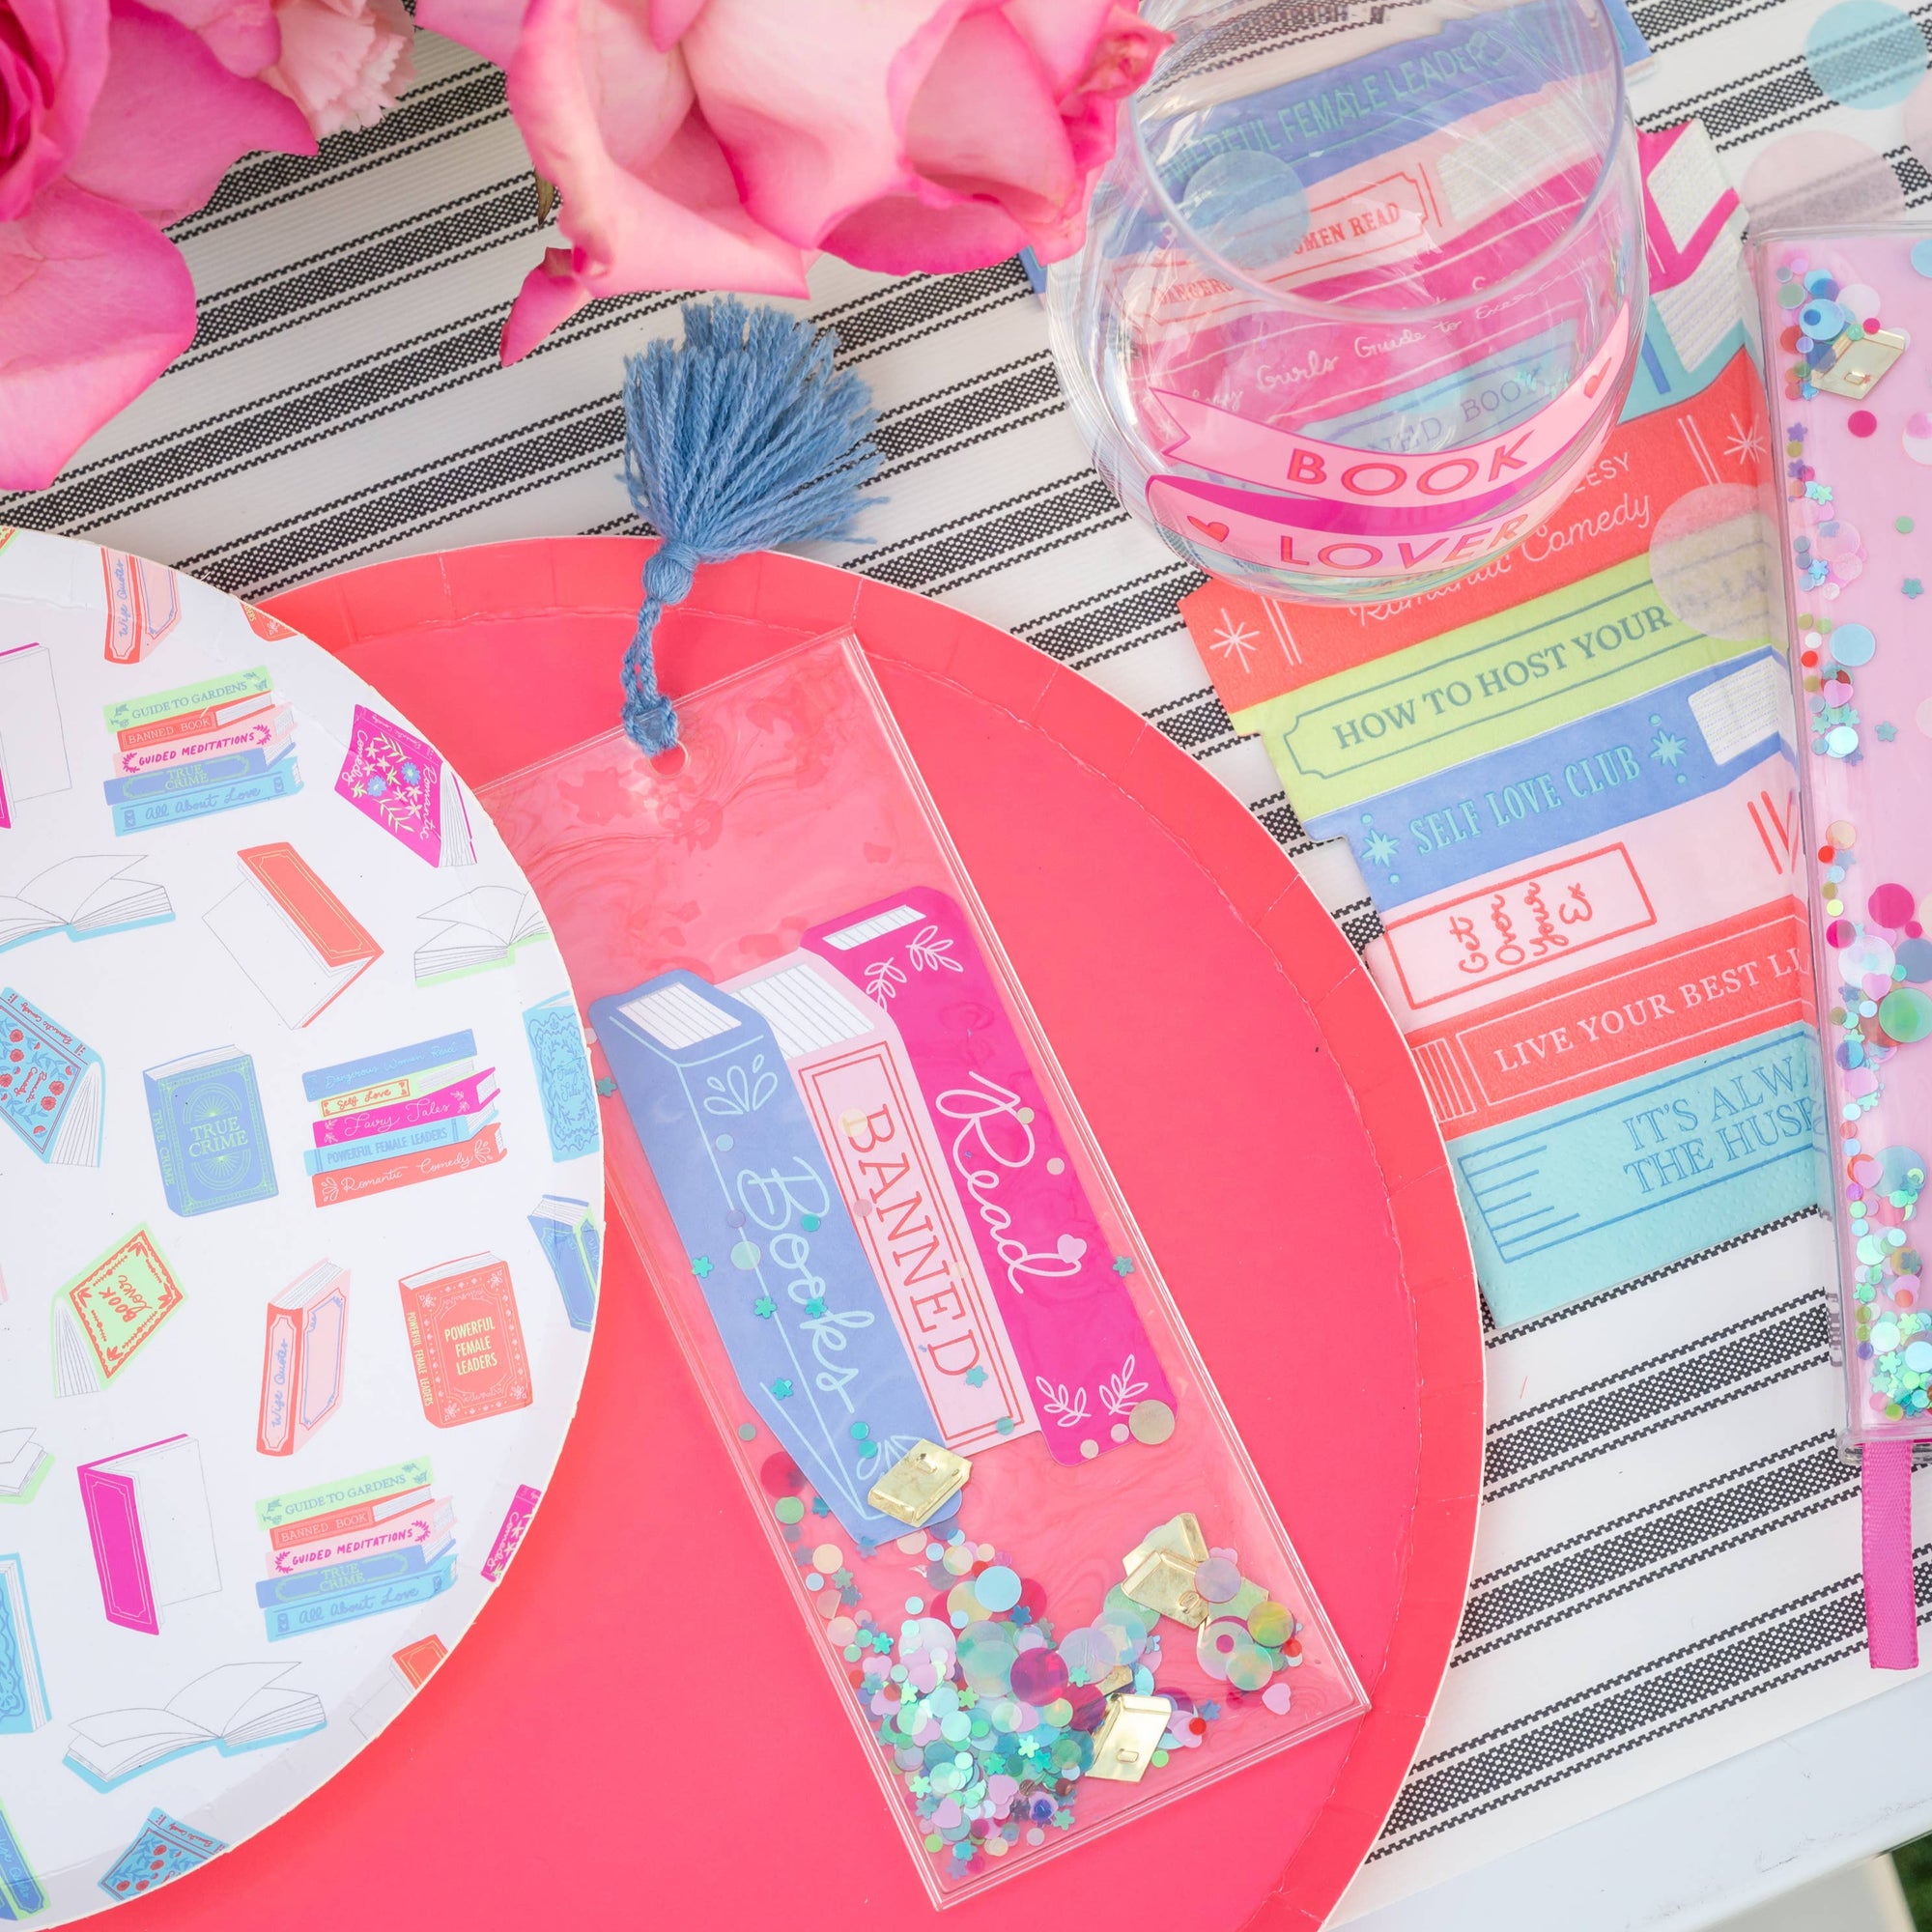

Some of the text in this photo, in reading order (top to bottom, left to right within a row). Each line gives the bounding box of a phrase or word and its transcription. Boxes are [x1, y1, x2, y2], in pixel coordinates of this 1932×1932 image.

[1277, 73, 1388, 144] FEMALE
[1348, 201, 1400, 238] READ
[1287, 429, 1537, 497] BOOK
[1280, 513, 1529, 571] LOVER
[1520, 493, 1652, 563] Comedy
[119, 558, 128, 601] Quotes
[1332, 605, 1674, 751] HOW TO HOST YOUR
[131, 680, 248, 721] GUIDE TO GARDENS
[128, 716, 212, 746] BANNED BOOK
[138, 731, 256, 767] GUIDED MEDITATIONS
[167, 764, 205, 781] TRUE
[341, 729, 368, 786] Comedy
[145, 784, 262, 821] All About Love
[164, 772, 209, 791] CRIME
[419, 761, 438, 841] Romantic
[1407, 745, 1642, 857] SELF LOVE CLUB
[1523, 881, 1570, 957] Your
[1558, 882, 1594, 925] Ex
[1449, 916, 1490, 974] Get
[1491, 894, 1526, 966] Over
[1492, 947, 1801, 1074] LIVE YOUR BEST LI
[324, 1065, 379, 1090] Dangerous
[336, 1087, 391, 1108] Self Love
[189, 1116, 242, 1142] TRUE
[344, 1097, 451, 1137] Fairy Tales
[1622, 1096, 1700, 1151] IT'S
[152, 1108, 176, 1187] TRUE CRIME
[187, 1128, 248, 1157] CRIME
[327, 1126, 448, 1166] POWERFUL FEMALE LEADERS
[340, 1152, 475, 1193] Romantic Comedy
[934, 1069, 1082, 1295] Read
[1623, 1138, 1716, 1195] THE
[838, 1102, 984, 1379] BANNED
[99, 1286, 138, 1323] BOOK
[735, 1155, 876, 1414] Books
[444, 1316, 497, 1343] POWERFUL
[455, 1336, 492, 1358] FEMALE
[407, 1311, 434, 1407] POWERFUL FEMALE LEADERS
[456, 1352, 498, 1377] LEADERS
[271, 1338, 289, 1429] Wise Quotes
[285, 1473, 407, 1516] GUIDE TO GARDENS
[280, 1511, 368, 1543] BANNED BOOK
[292, 1528, 413, 1566] GUIDED MEDITATIONS
[319, 1573, 365, 1593] CRIME
[321, 1563, 360, 1581] TRUE
[298, 1585, 420, 1625] All About Love
